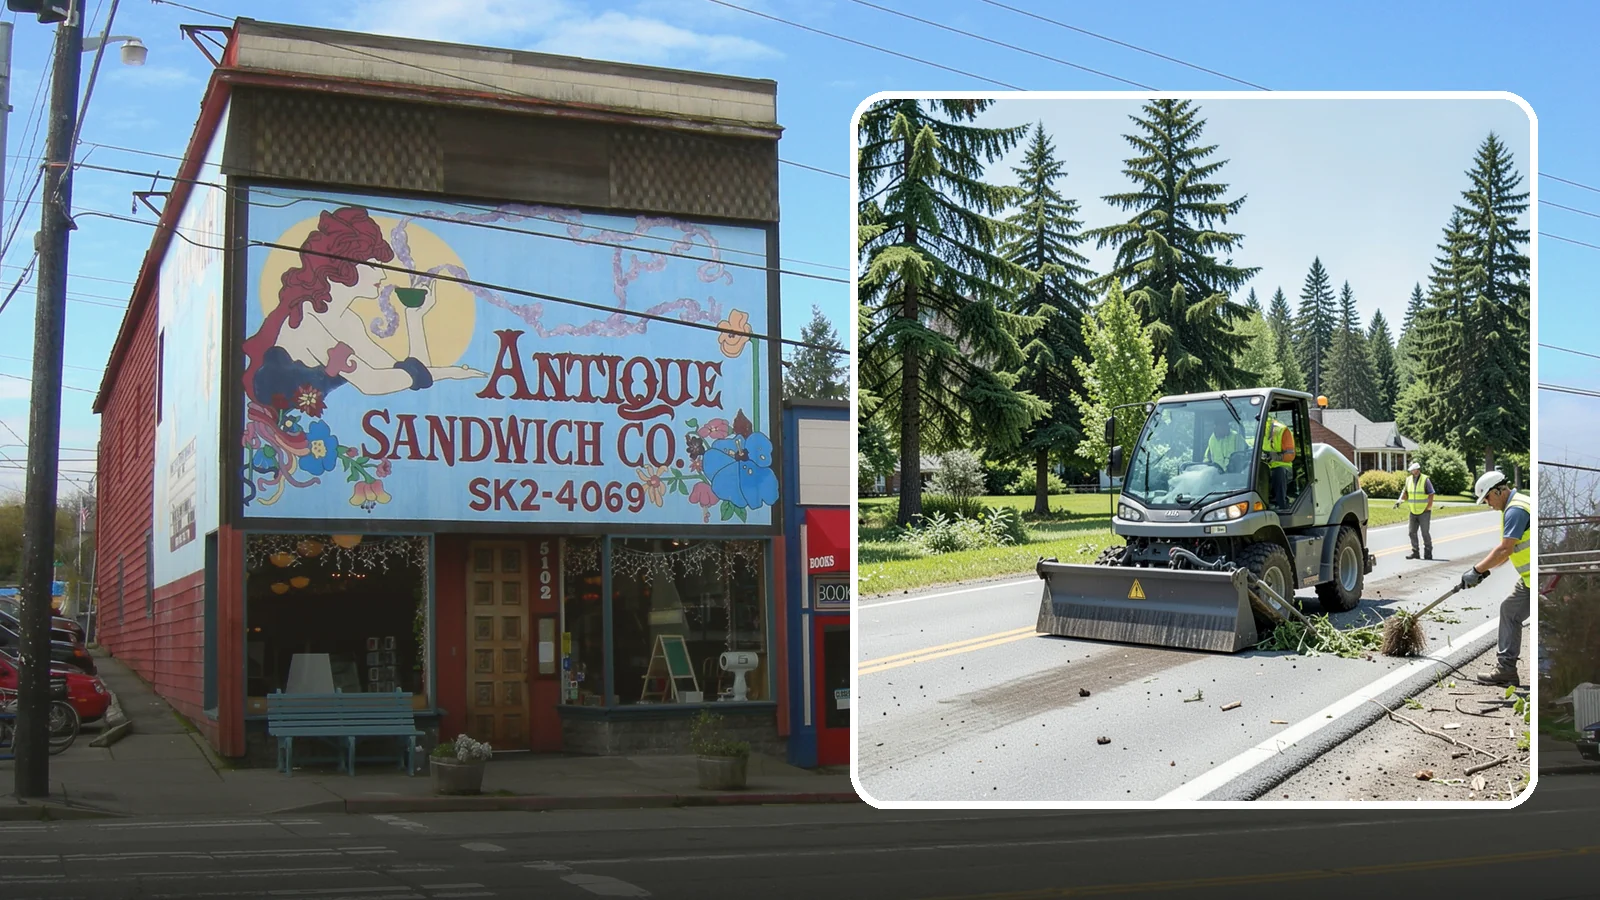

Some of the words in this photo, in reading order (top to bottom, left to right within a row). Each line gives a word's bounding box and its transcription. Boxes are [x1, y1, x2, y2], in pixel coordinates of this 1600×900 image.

[476, 330, 724, 421] ANTIQUE
[361, 408, 605, 467] SANDWICH
[617, 421, 685, 469] CO.
[468, 477, 646, 513] SK2-4069
[540, 541, 551, 600] 5102
[809, 555, 835, 569] BOOKS
